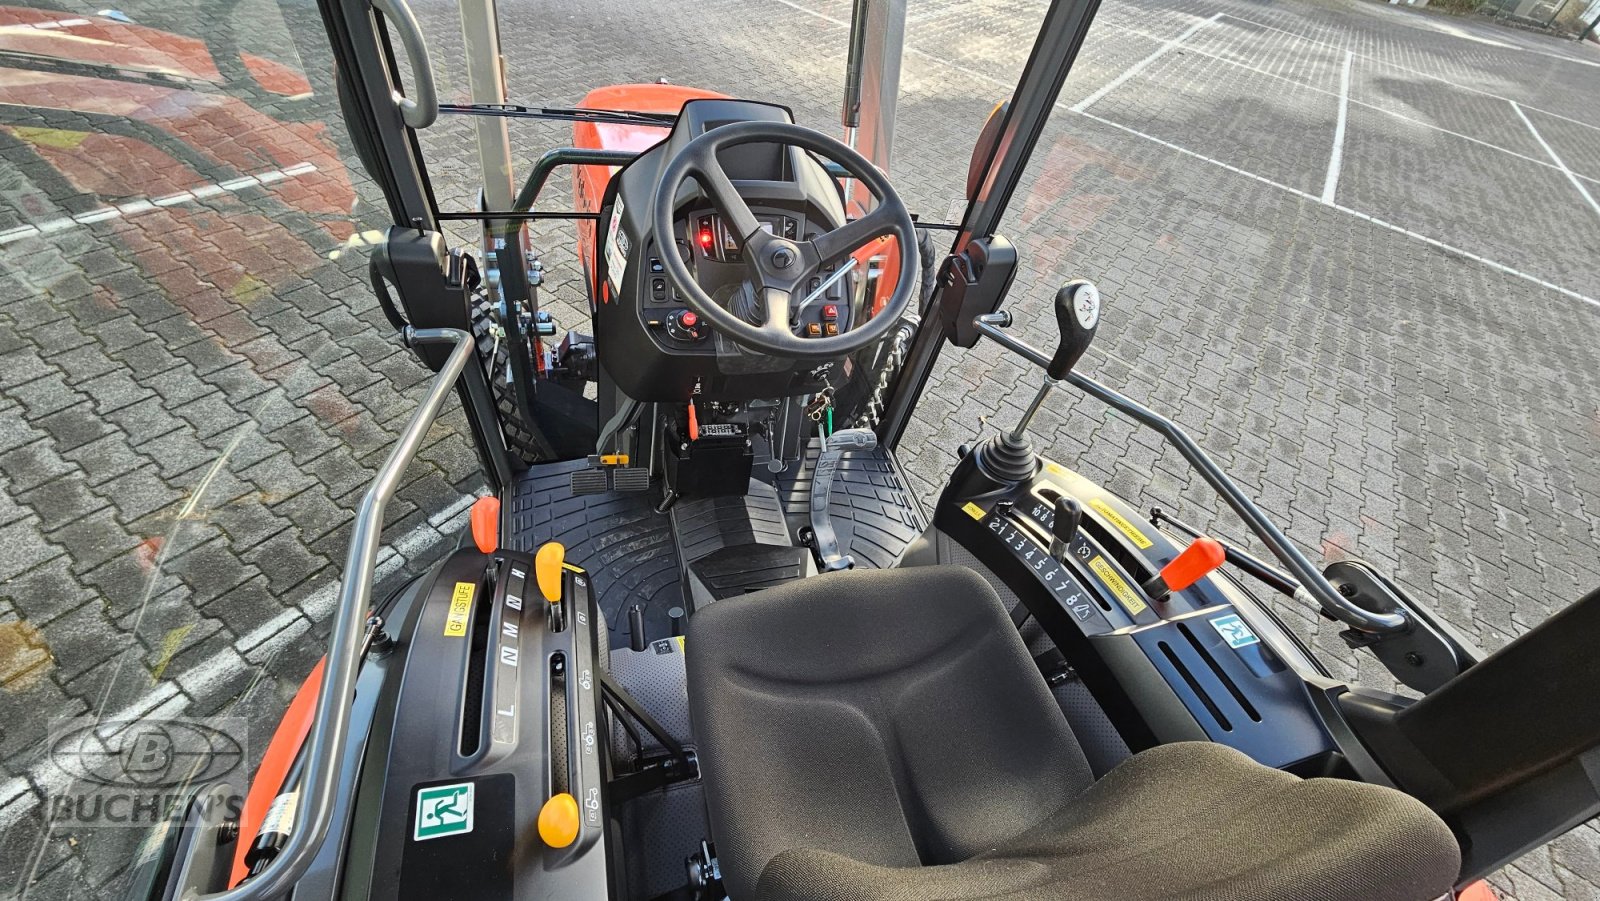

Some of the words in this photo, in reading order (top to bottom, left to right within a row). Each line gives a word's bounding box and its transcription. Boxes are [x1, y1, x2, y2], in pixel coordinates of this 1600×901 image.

[1032, 507, 1041, 516] 10
[511, 568, 526, 579] H
[1005, 533, 1015, 543] 2
[1015, 541, 1025, 551] 3
[1025, 550, 1034, 560] 4
[1035, 559, 1045, 569] 5
[1045, 571, 1056, 580] 6
[1055, 581, 1067, 591] 7
[1066, 595, 1078, 605] 8
[1095, 561, 1140, 609] GESCHWINDIGKEIT
[450, 585, 471, 632] GANGSTUFE
[502, 621, 519, 638] M
[498, 704, 515, 716] L
